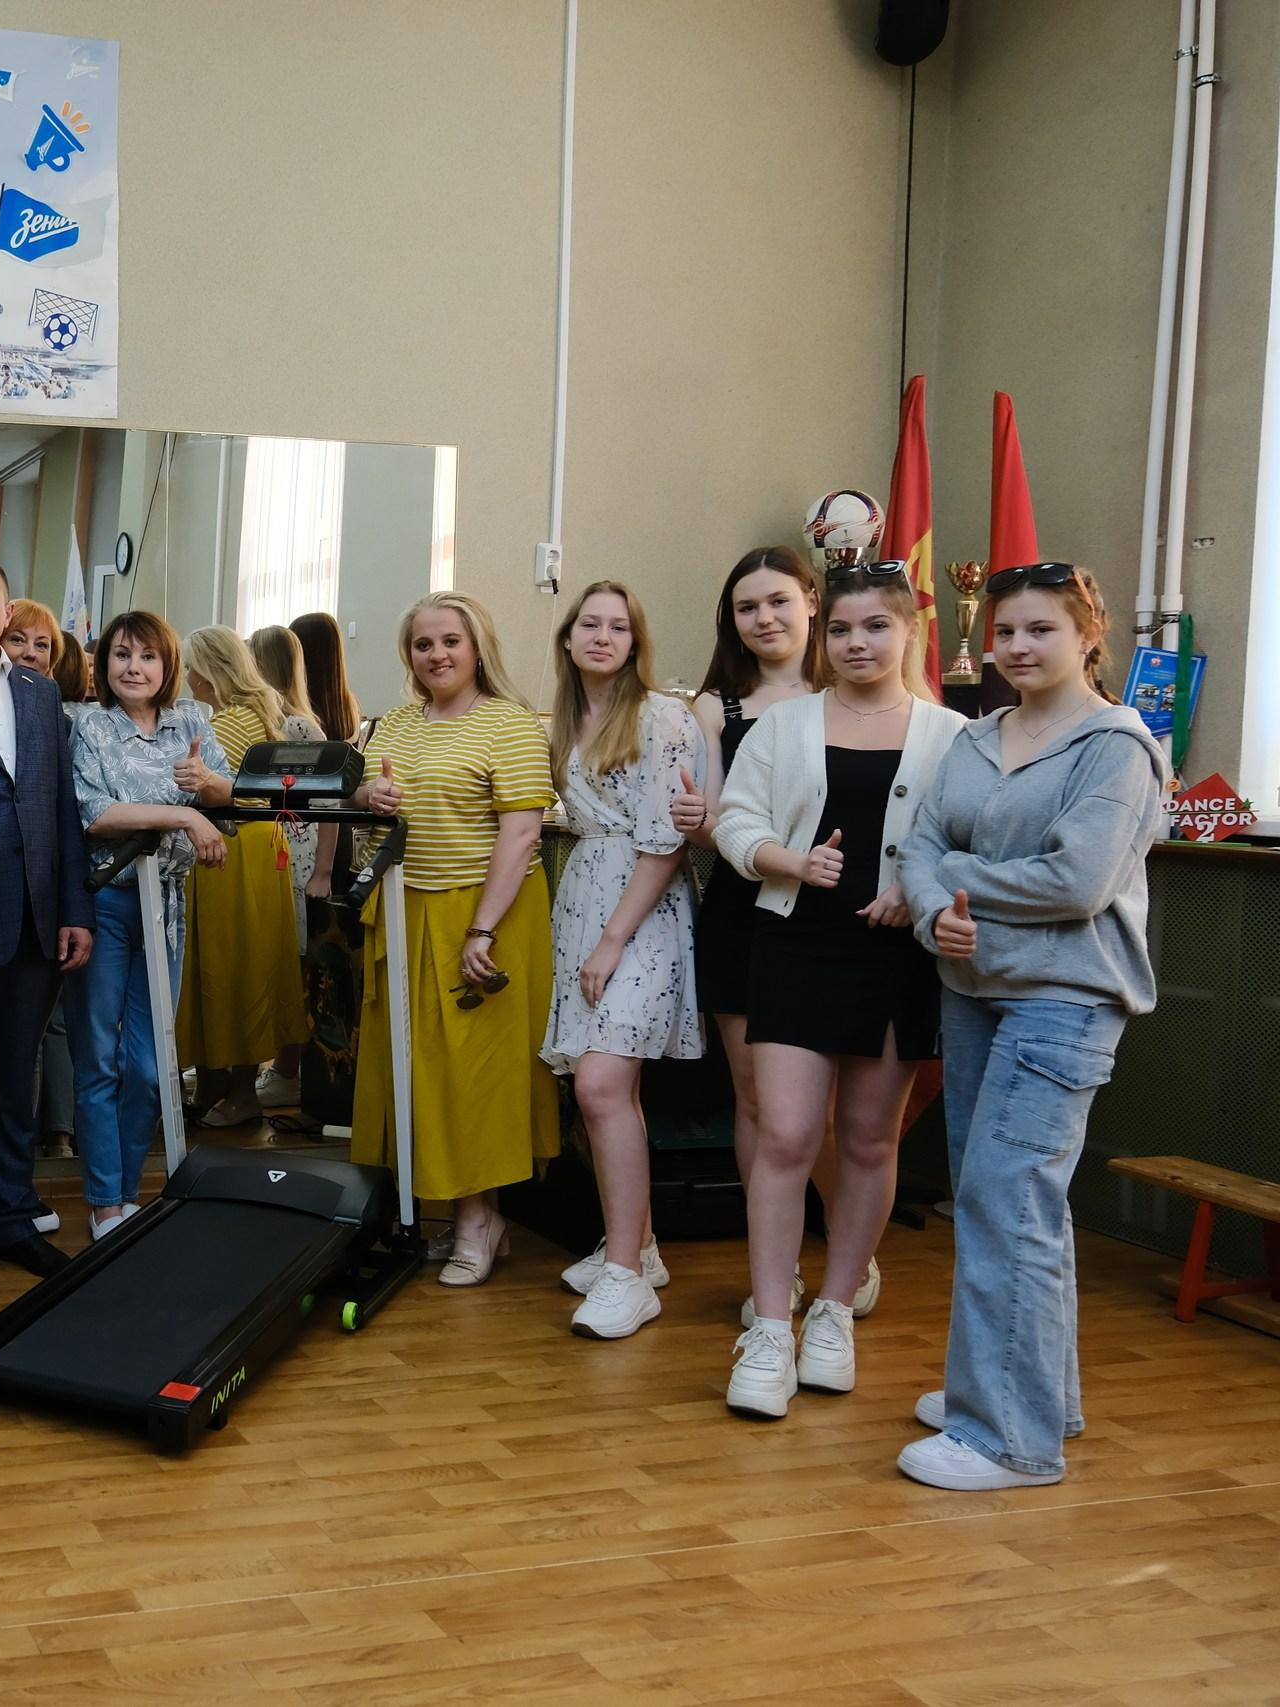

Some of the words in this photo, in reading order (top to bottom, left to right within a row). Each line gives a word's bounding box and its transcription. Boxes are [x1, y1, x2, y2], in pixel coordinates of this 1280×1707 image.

[1166, 798, 1236, 812] DANCE
[1171, 813, 1253, 828] FACTOR
[1196, 821, 1215, 842] 2
[210, 1366, 246, 1415] INITA
